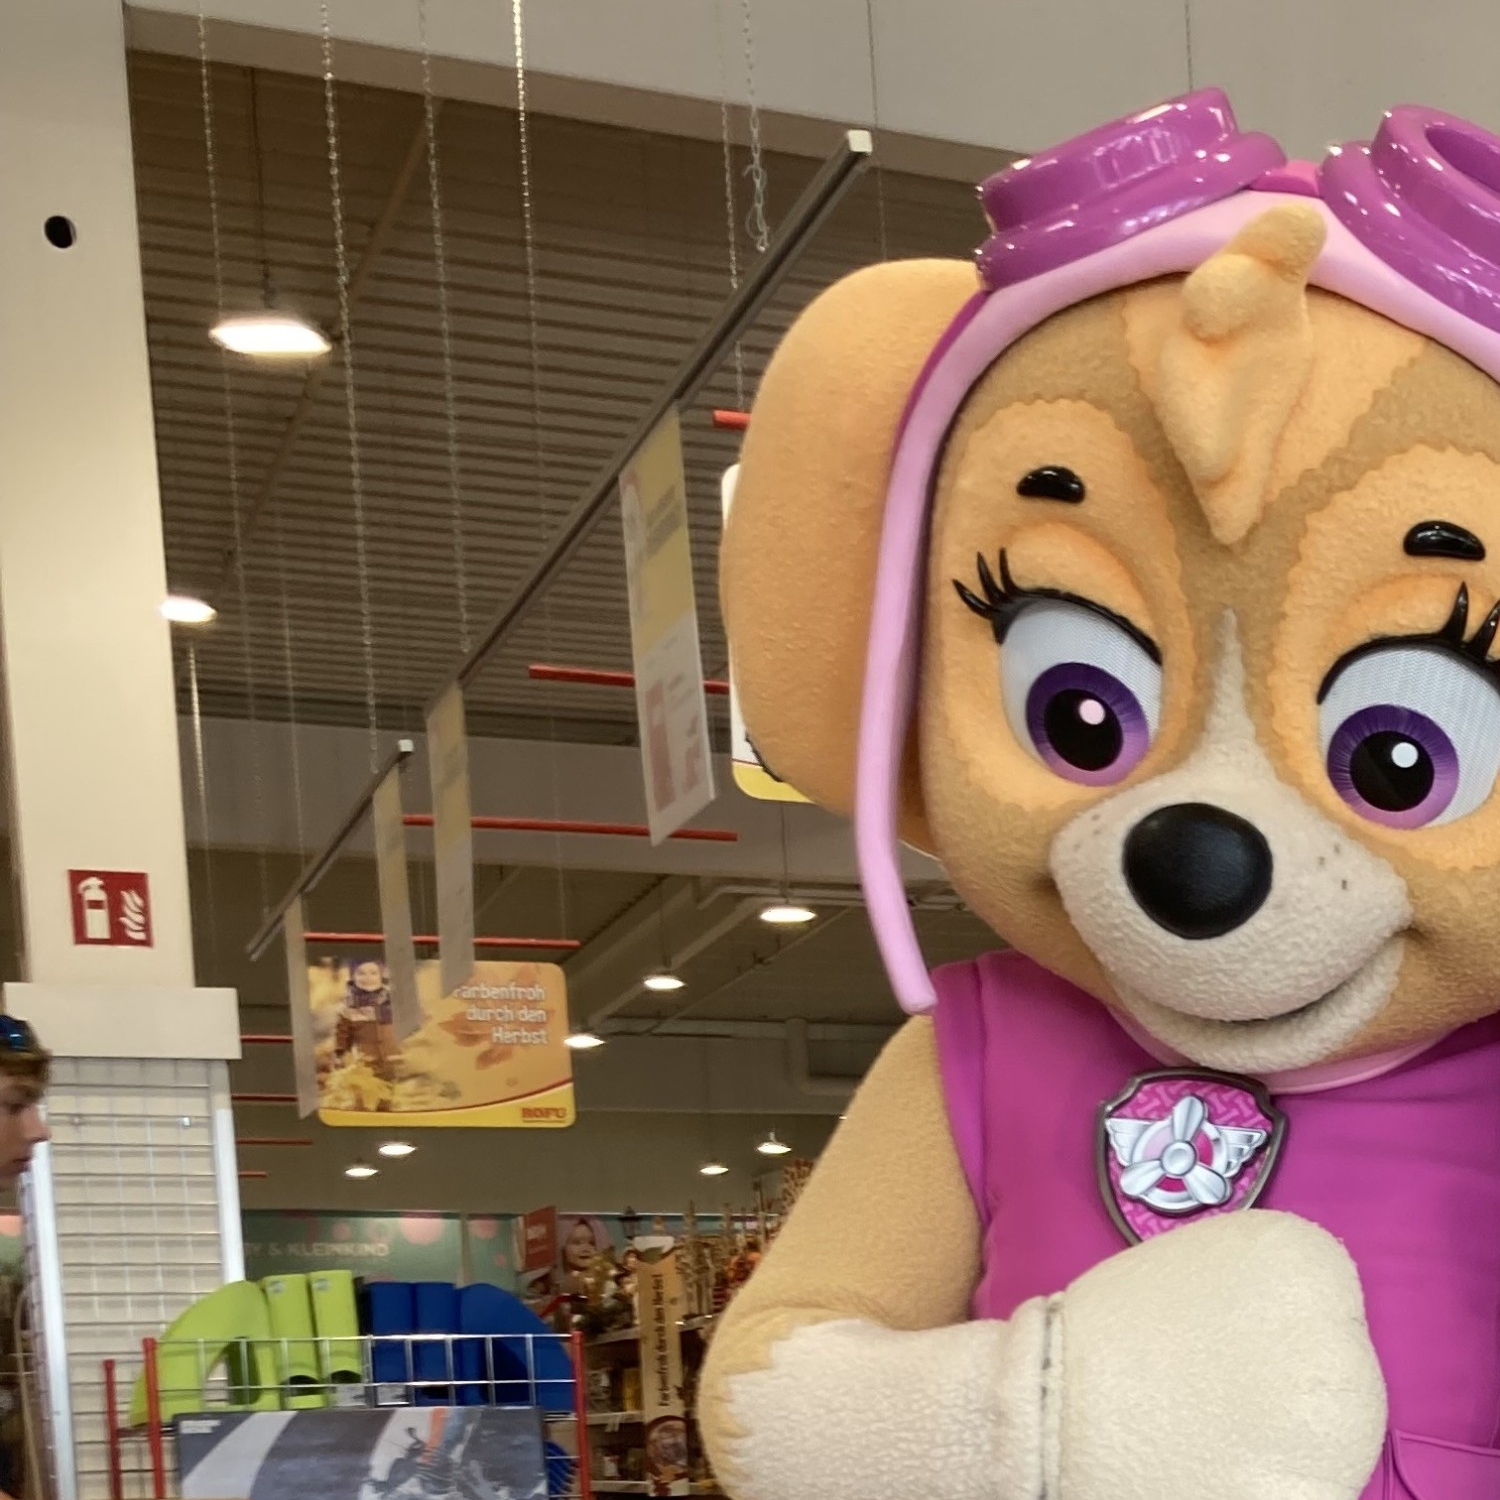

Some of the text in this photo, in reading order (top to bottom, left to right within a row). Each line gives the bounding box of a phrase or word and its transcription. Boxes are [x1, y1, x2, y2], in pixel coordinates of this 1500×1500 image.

[466, 1006, 547, 1022] durch den
[491, 1027, 548, 1044] Herbst
